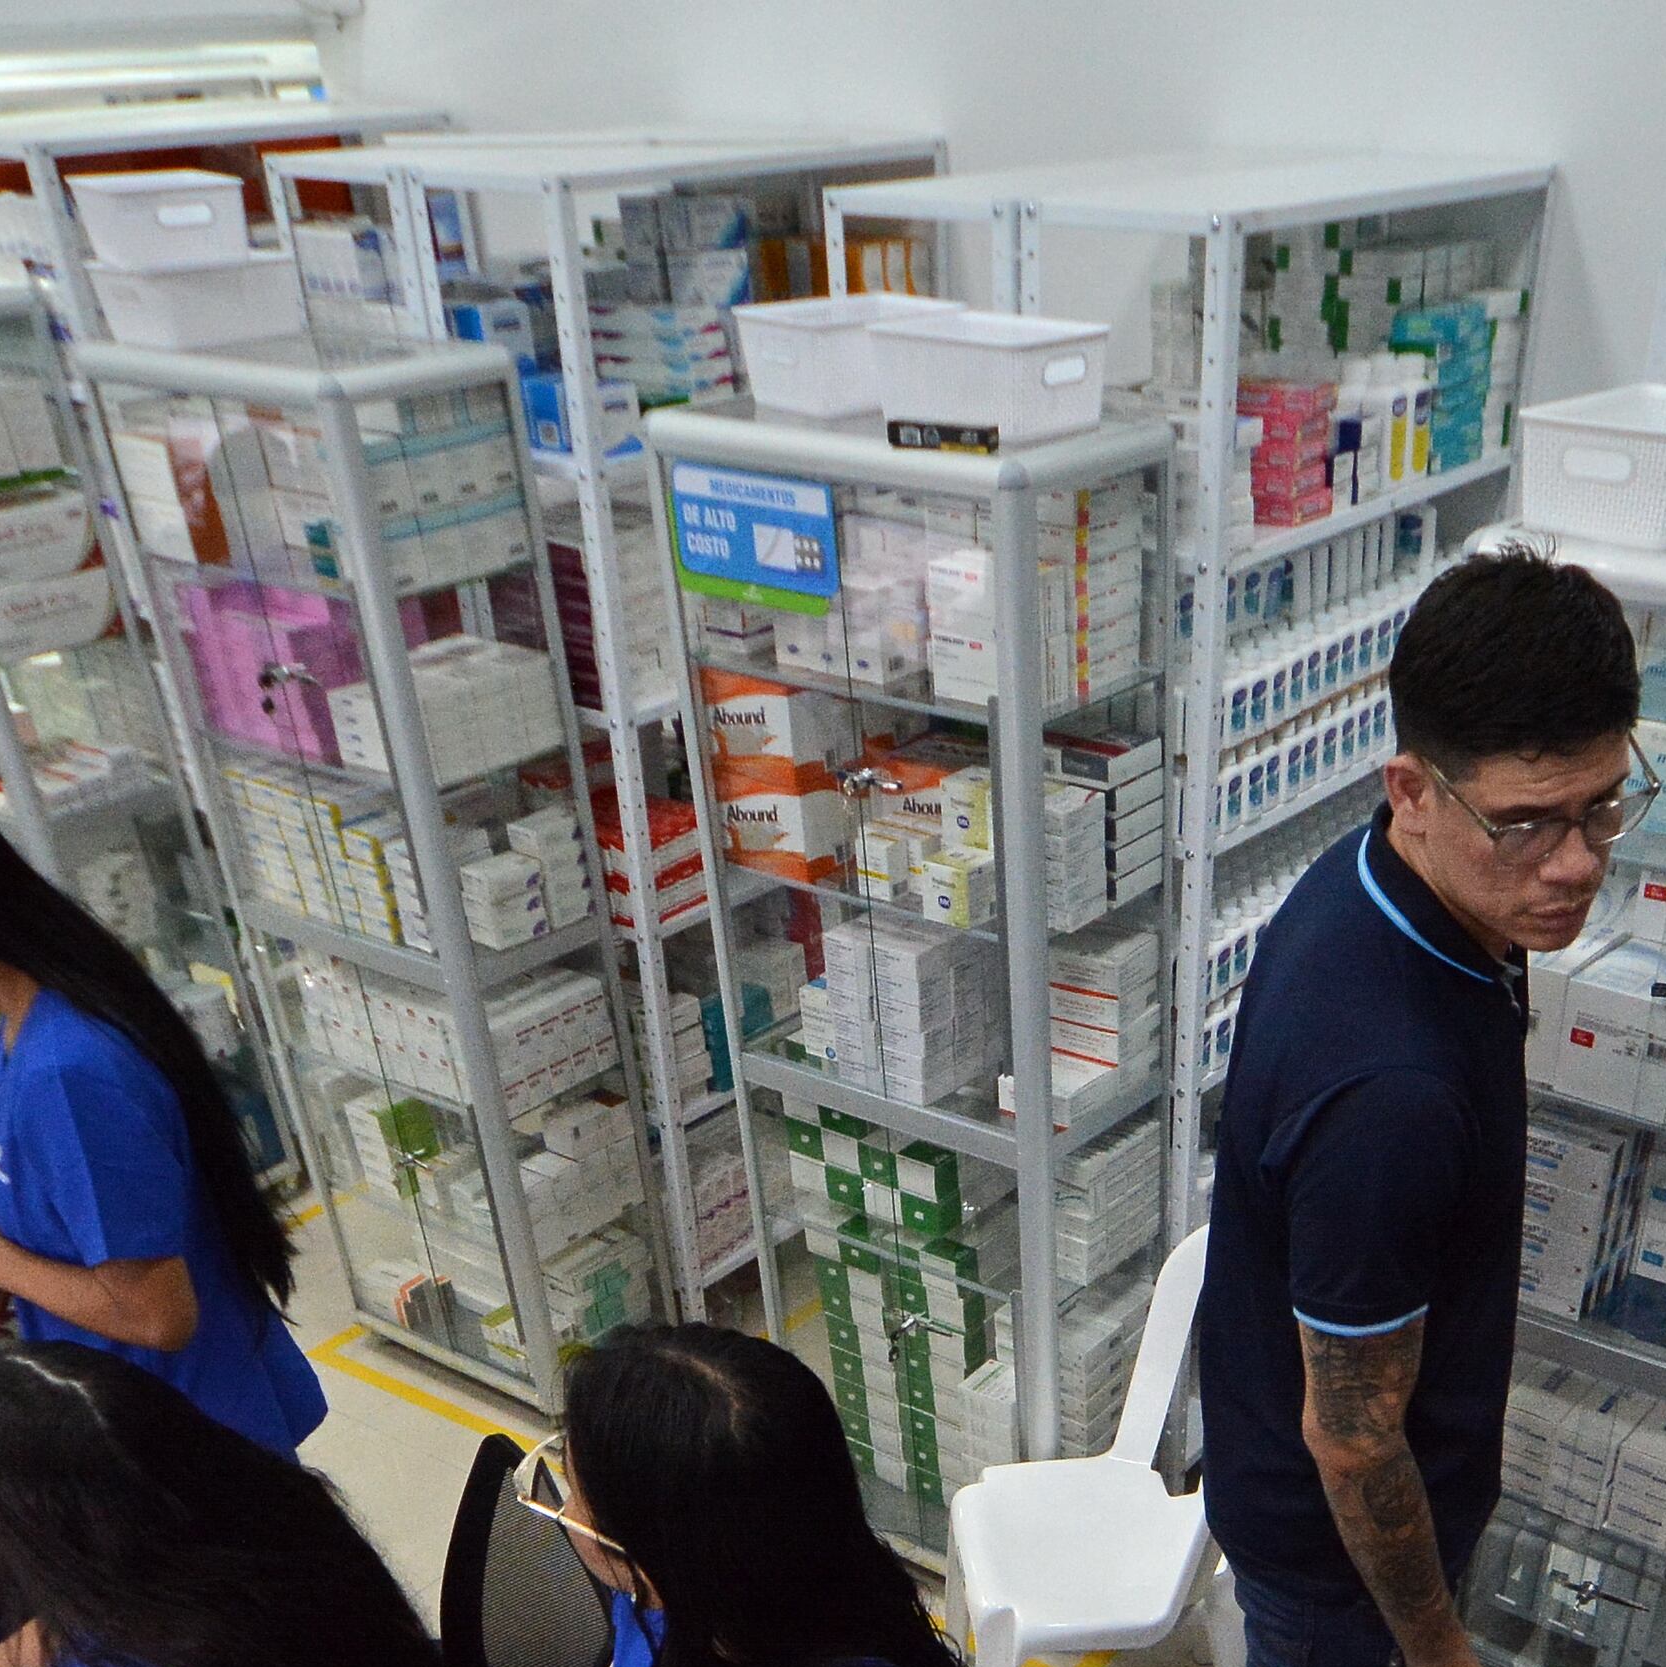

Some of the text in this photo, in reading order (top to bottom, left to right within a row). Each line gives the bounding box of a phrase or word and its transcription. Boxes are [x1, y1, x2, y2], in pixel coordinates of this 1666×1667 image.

[710, 480, 797, 506] MEDICAMENTOS
[684, 503, 737, 531] DE ALTO
[686, 531, 730, 560] COSTO
[714, 707, 765, 725] Abound
[727, 804, 778, 823] Abound
